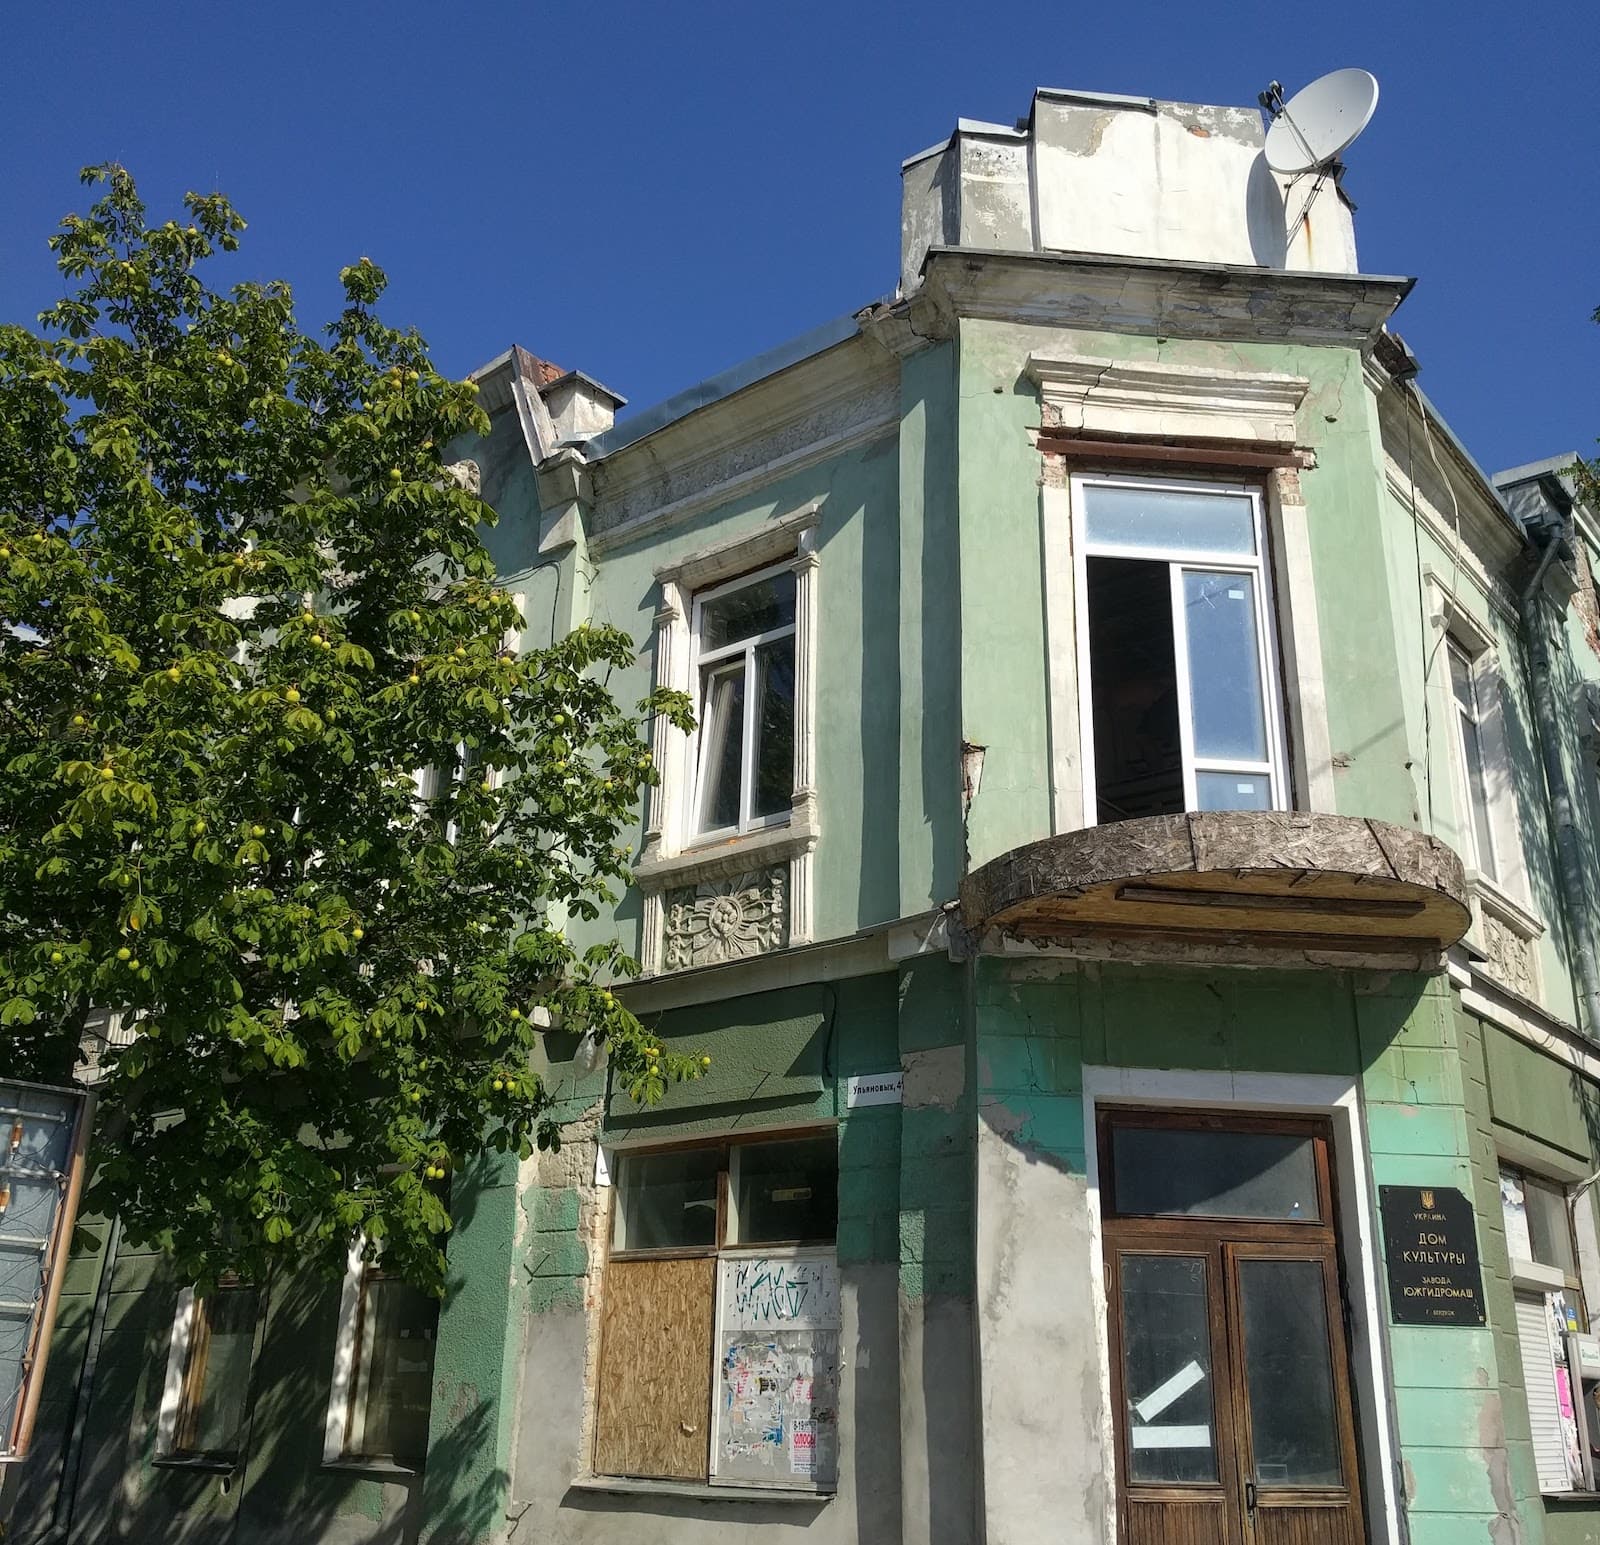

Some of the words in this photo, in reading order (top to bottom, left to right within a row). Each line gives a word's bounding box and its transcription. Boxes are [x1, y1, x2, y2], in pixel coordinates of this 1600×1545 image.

[853, 1083, 895, 1095] Ульяновых,
[1413, 1212, 1446, 1221] УКРАИНА
[1418, 1232, 1447, 1245] ДОМ
[1402, 1251, 1466, 1265] КУЛЬТУРЫ
[1422, 1276, 1452, 1285] ЗАВОДА
[1403, 1287, 1474, 1298] ЮЖГИДРОМАШ
